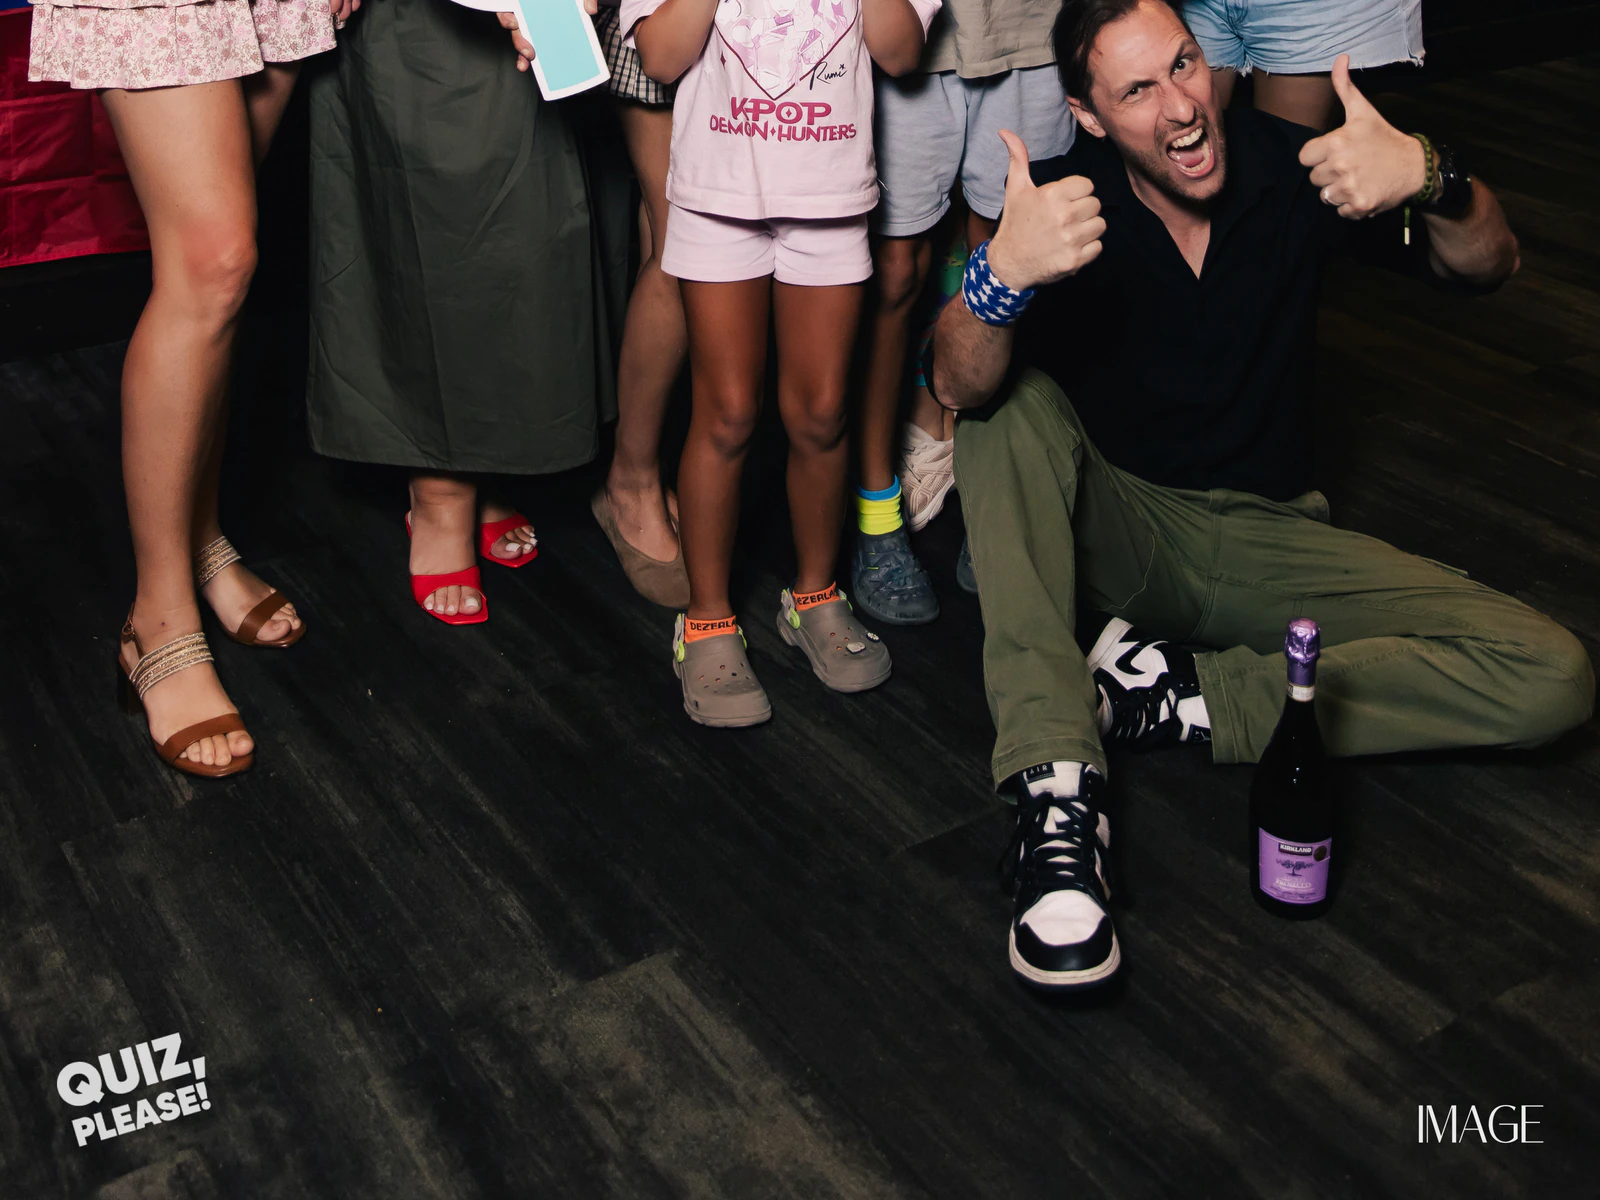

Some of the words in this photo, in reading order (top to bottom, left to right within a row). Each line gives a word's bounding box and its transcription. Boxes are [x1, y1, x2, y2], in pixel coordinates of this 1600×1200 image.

[809, 61, 847, 90] Rumi
[731, 96, 832, 125] KPOP
[710, 114, 769, 141] DEMON
[777, 123, 857, 142] HUNTERS
[1030, 764, 1047, 774] AIR
[1280, 844, 1312, 853] KIRKLAND
